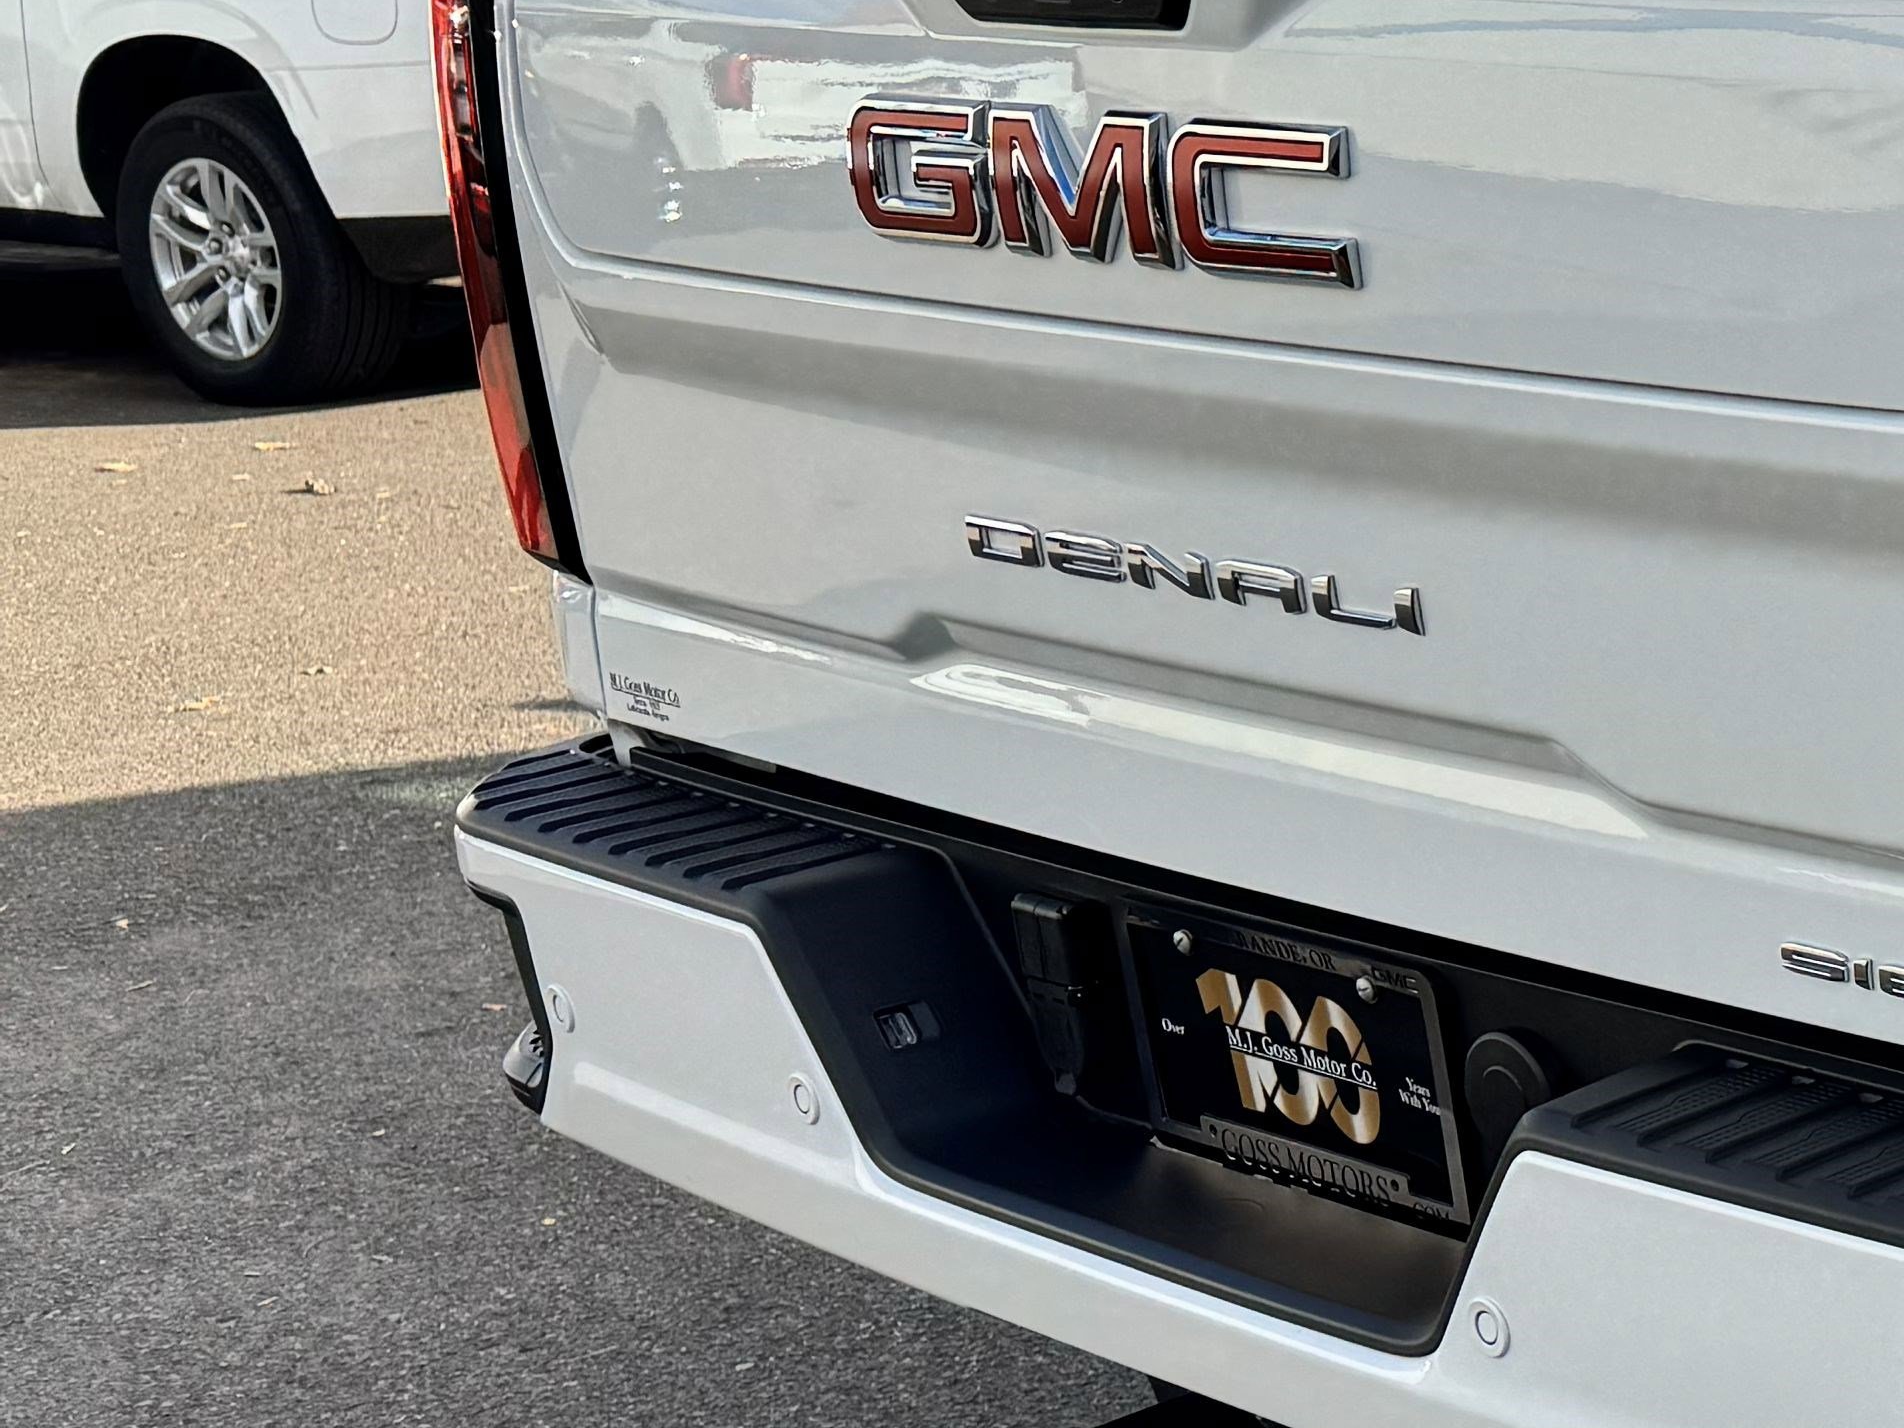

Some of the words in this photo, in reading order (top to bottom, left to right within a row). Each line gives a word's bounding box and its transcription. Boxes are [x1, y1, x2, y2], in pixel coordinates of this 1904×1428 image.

[847, 92, 1364, 291] GMC
[964, 514, 1427, 637] DENALI
[1309, 948, 1336, 971] OR
[1161, 1018, 1185, 1035] Over
[1195, 968, 1380, 1145] 100
[1225, 1025, 1257, 1054] M.J.
[1261, 1035, 1299, 1063] Goss
[1301, 1046, 1347, 1078] Motor
[1351, 1061, 1377, 1087] Co.
[1399, 1088, 1423, 1109] With
[1405, 1077, 1431, 1098] Years
[1221, 1127, 1281, 1174] GOSS
[1287, 1146, 1391, 1206] MOTORS
